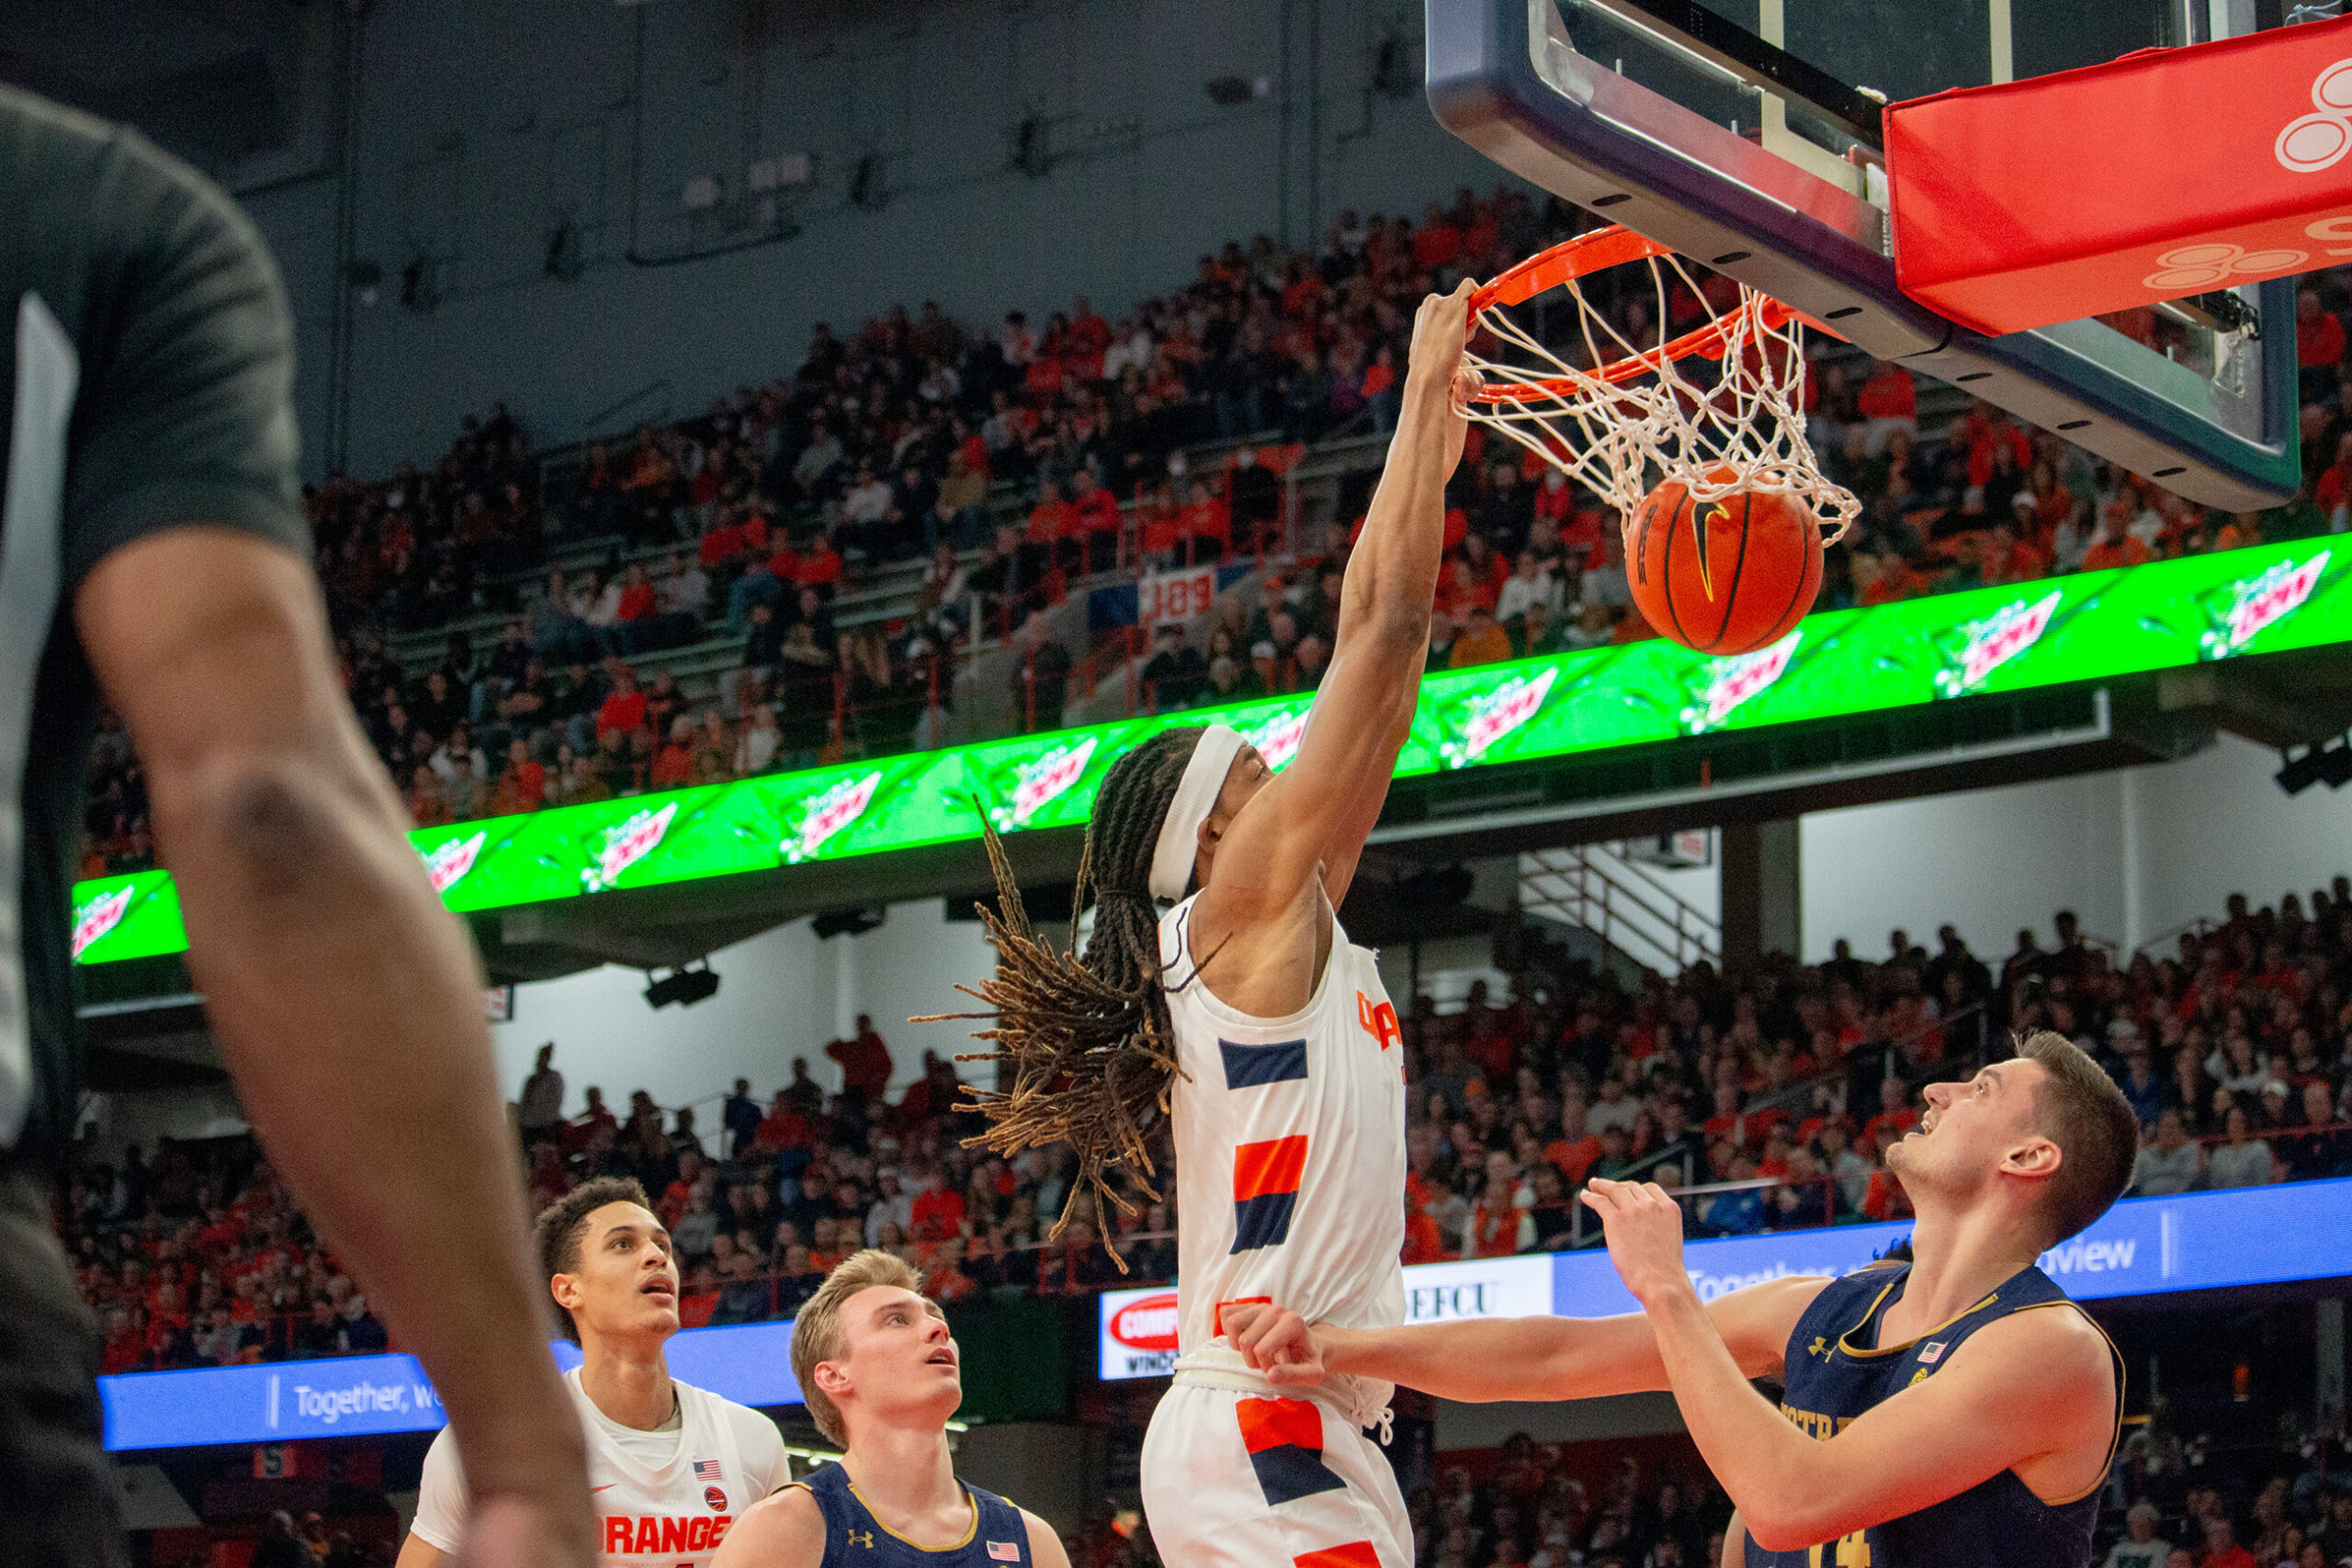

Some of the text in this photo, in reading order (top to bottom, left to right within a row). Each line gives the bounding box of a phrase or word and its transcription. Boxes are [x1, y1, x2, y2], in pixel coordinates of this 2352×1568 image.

[1405, 1280, 1501, 1320] EFCU
[293, 1381, 412, 1424] Together,
[594, 1516, 732, 1554] RANGE
